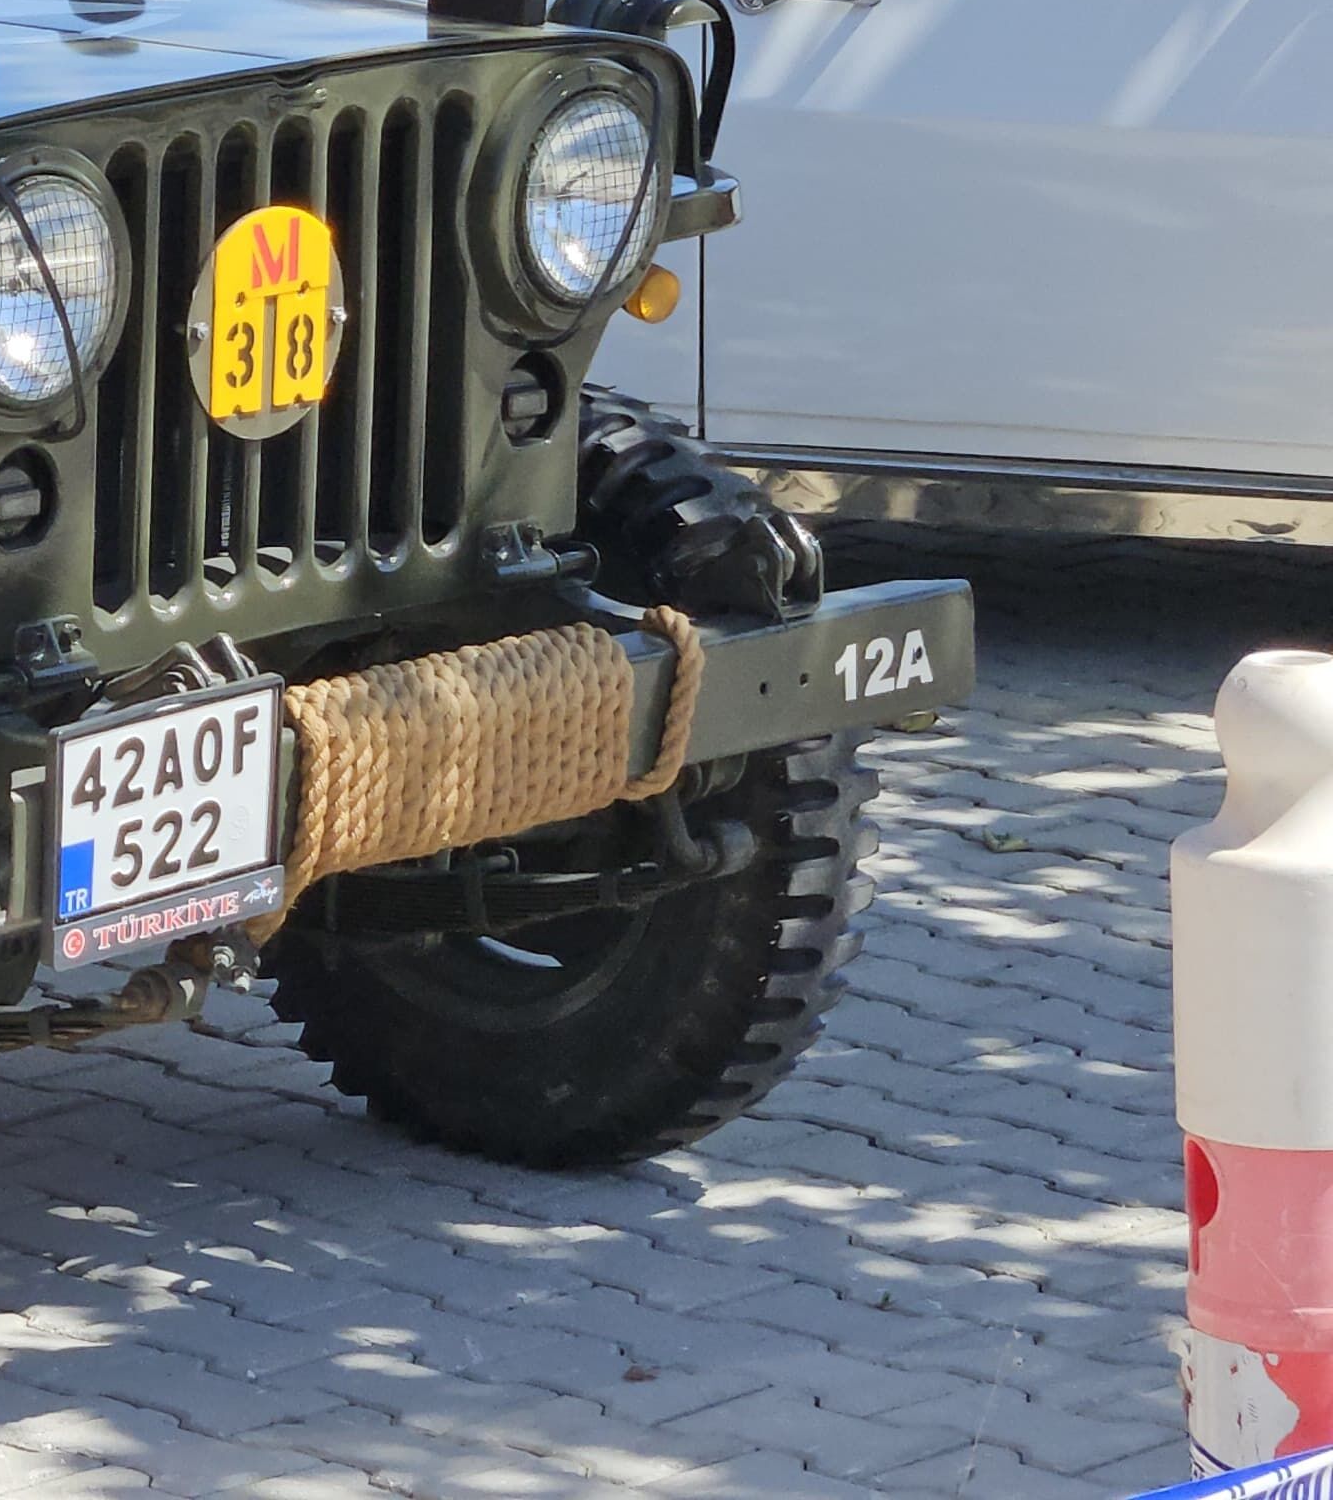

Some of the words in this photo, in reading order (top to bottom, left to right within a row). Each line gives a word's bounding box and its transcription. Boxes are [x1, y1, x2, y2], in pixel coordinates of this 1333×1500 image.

[251, 216, 301, 289] M
[834, 629, 934, 702] 12A
[110, 800, 222, 888] 522
[65, 887, 90, 913] TR
[92, 891, 240, 951] TÜRKİYE
